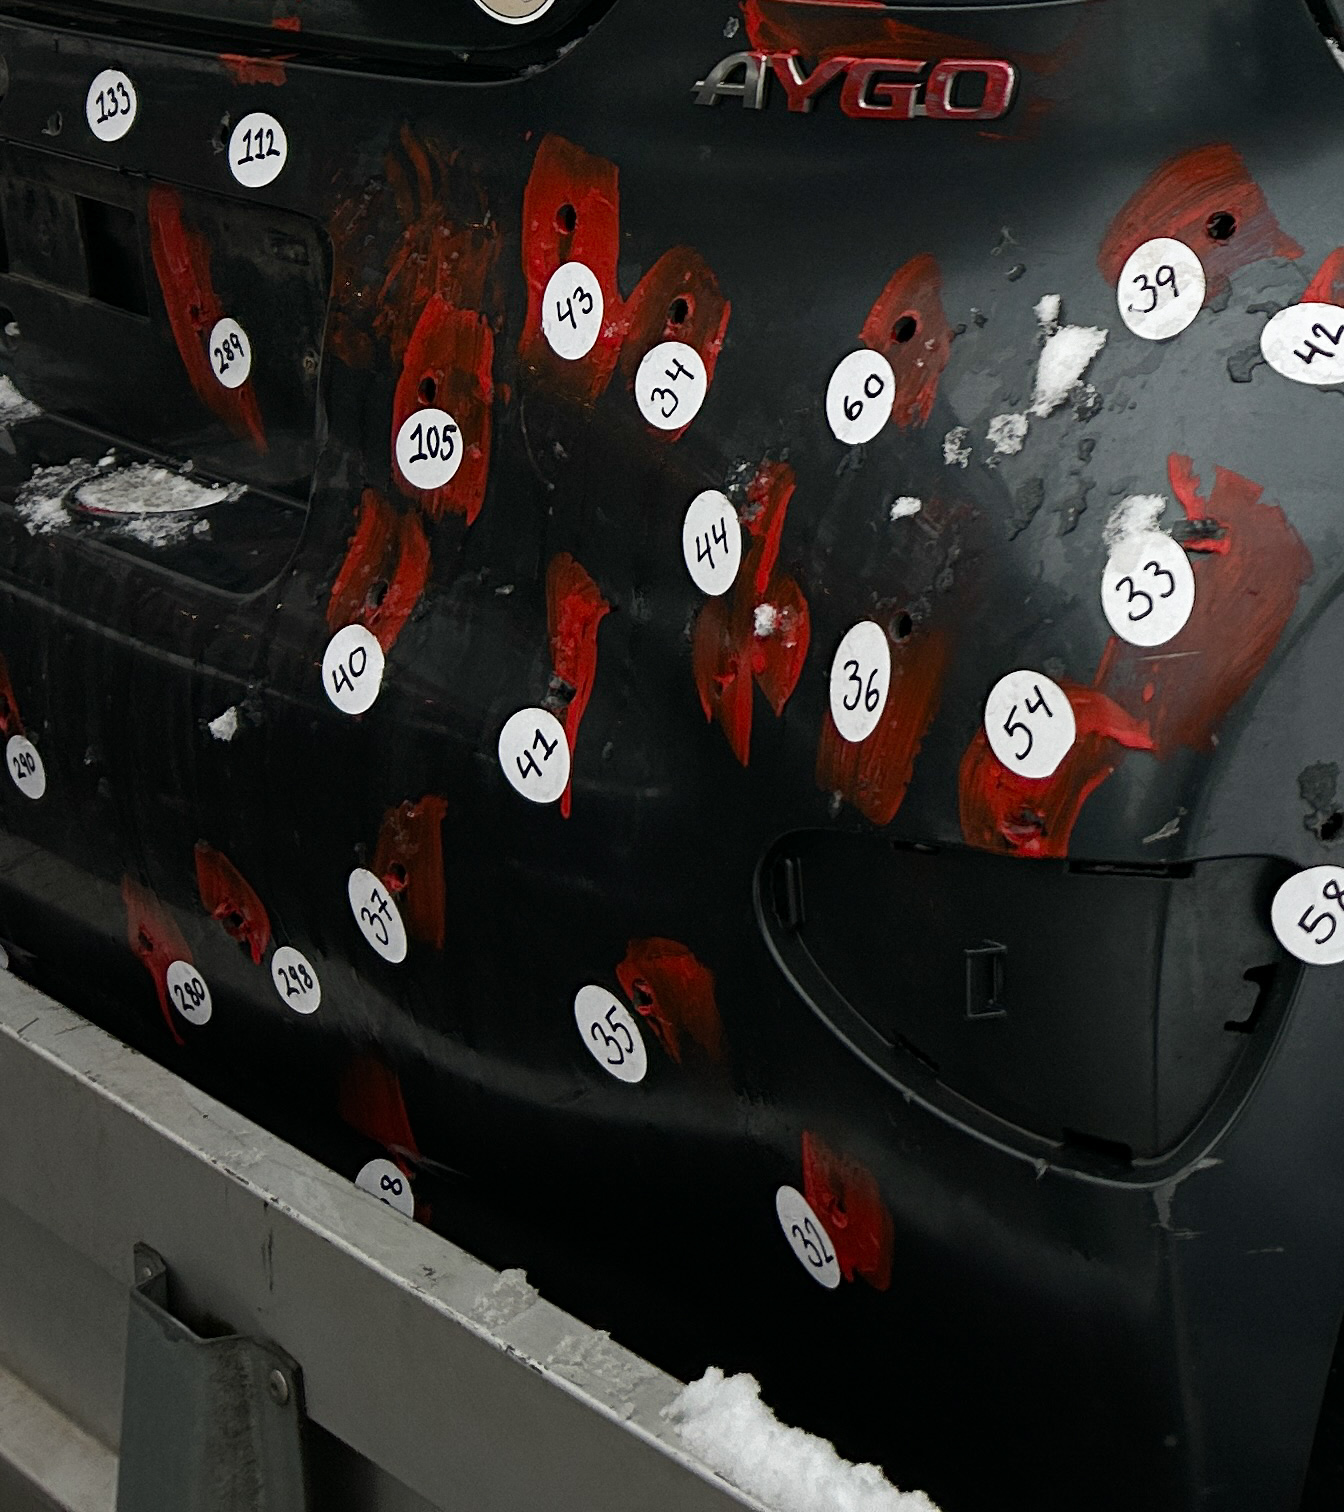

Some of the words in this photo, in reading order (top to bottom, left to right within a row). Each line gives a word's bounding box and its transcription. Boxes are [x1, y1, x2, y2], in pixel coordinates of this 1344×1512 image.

[96, 82, 130, 124] 133
[690, 50, 1016, 120] AYGO
[238, 128, 280, 165] 112
[557, 286, 593, 329] 43
[1128, 265, 1179, 313] 39
[214, 333, 244, 374] 289
[1293, 323, 1344, 364] 42
[651, 358, 694, 418] 34
[844, 374, 884, 421] 60
[409, 423, 456, 463] 105
[696, 517, 728, 569] 44
[1116, 561, 1175, 621] 33
[332, 647, 367, 693] 40
[843, 660, 879, 712] 36
[1003, 685, 1053, 760] 54
[13, 752, 36, 779] 290
[516, 729, 558, 779] 41
[361, 888, 392, 945] 37
[174, 977, 205, 1011] 280
[278, 964, 313, 998] 298
[591, 1005, 635, 1065] 35
[792, 1217, 834, 1268] 32
